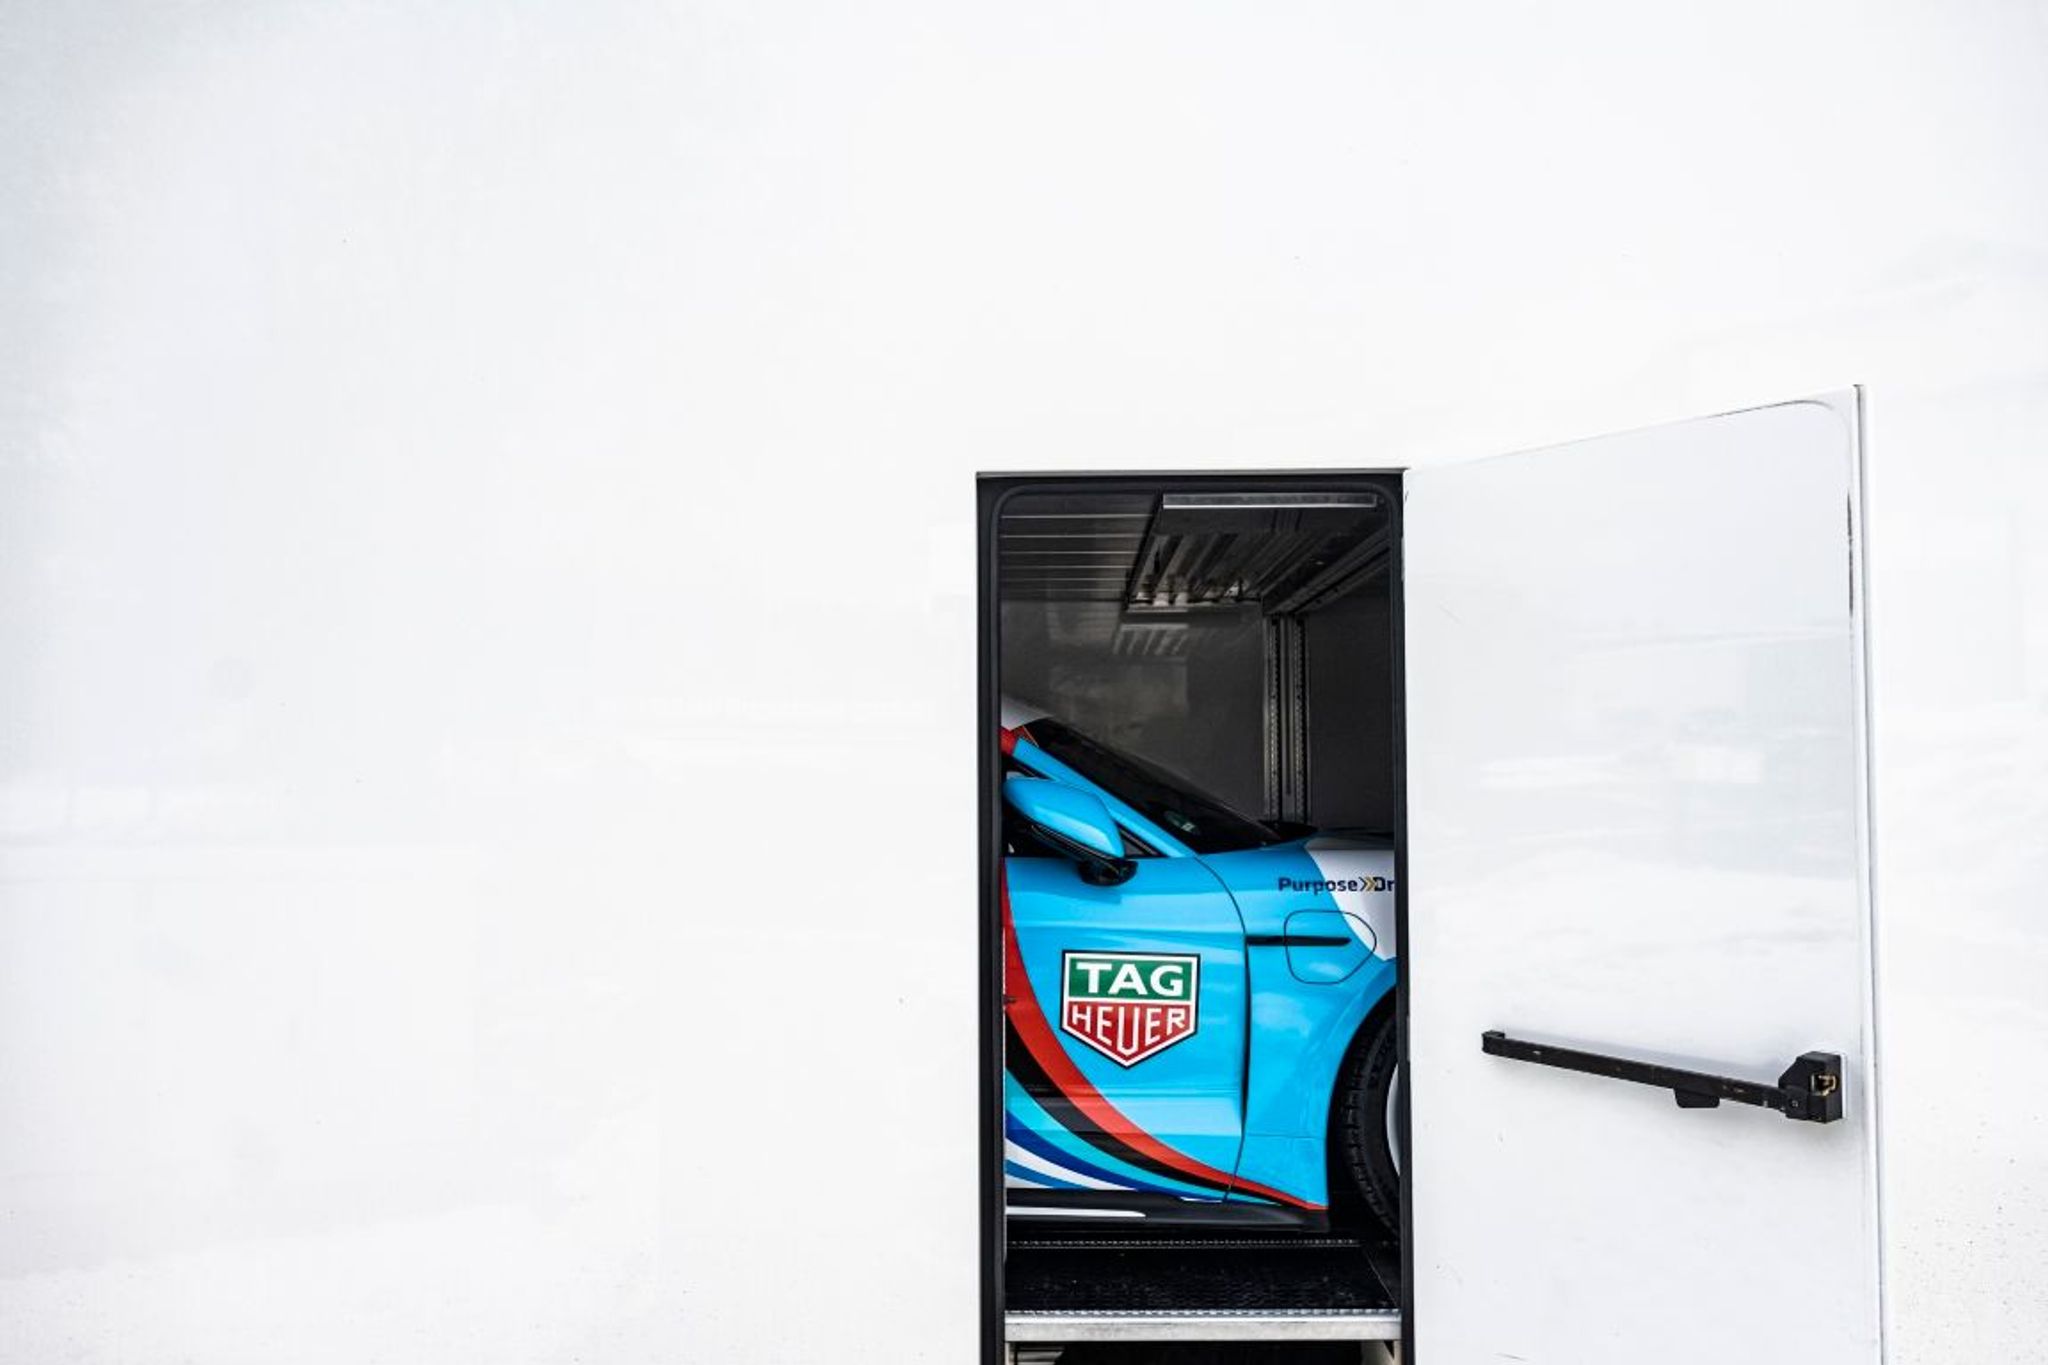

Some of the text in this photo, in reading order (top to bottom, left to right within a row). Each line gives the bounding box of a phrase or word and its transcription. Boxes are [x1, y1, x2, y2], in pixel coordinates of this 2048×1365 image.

[1278, 877, 1357, 895] Purpose
[1076, 962, 1184, 996] TAG
[1071, 1005, 1186, 1056] HEUER
